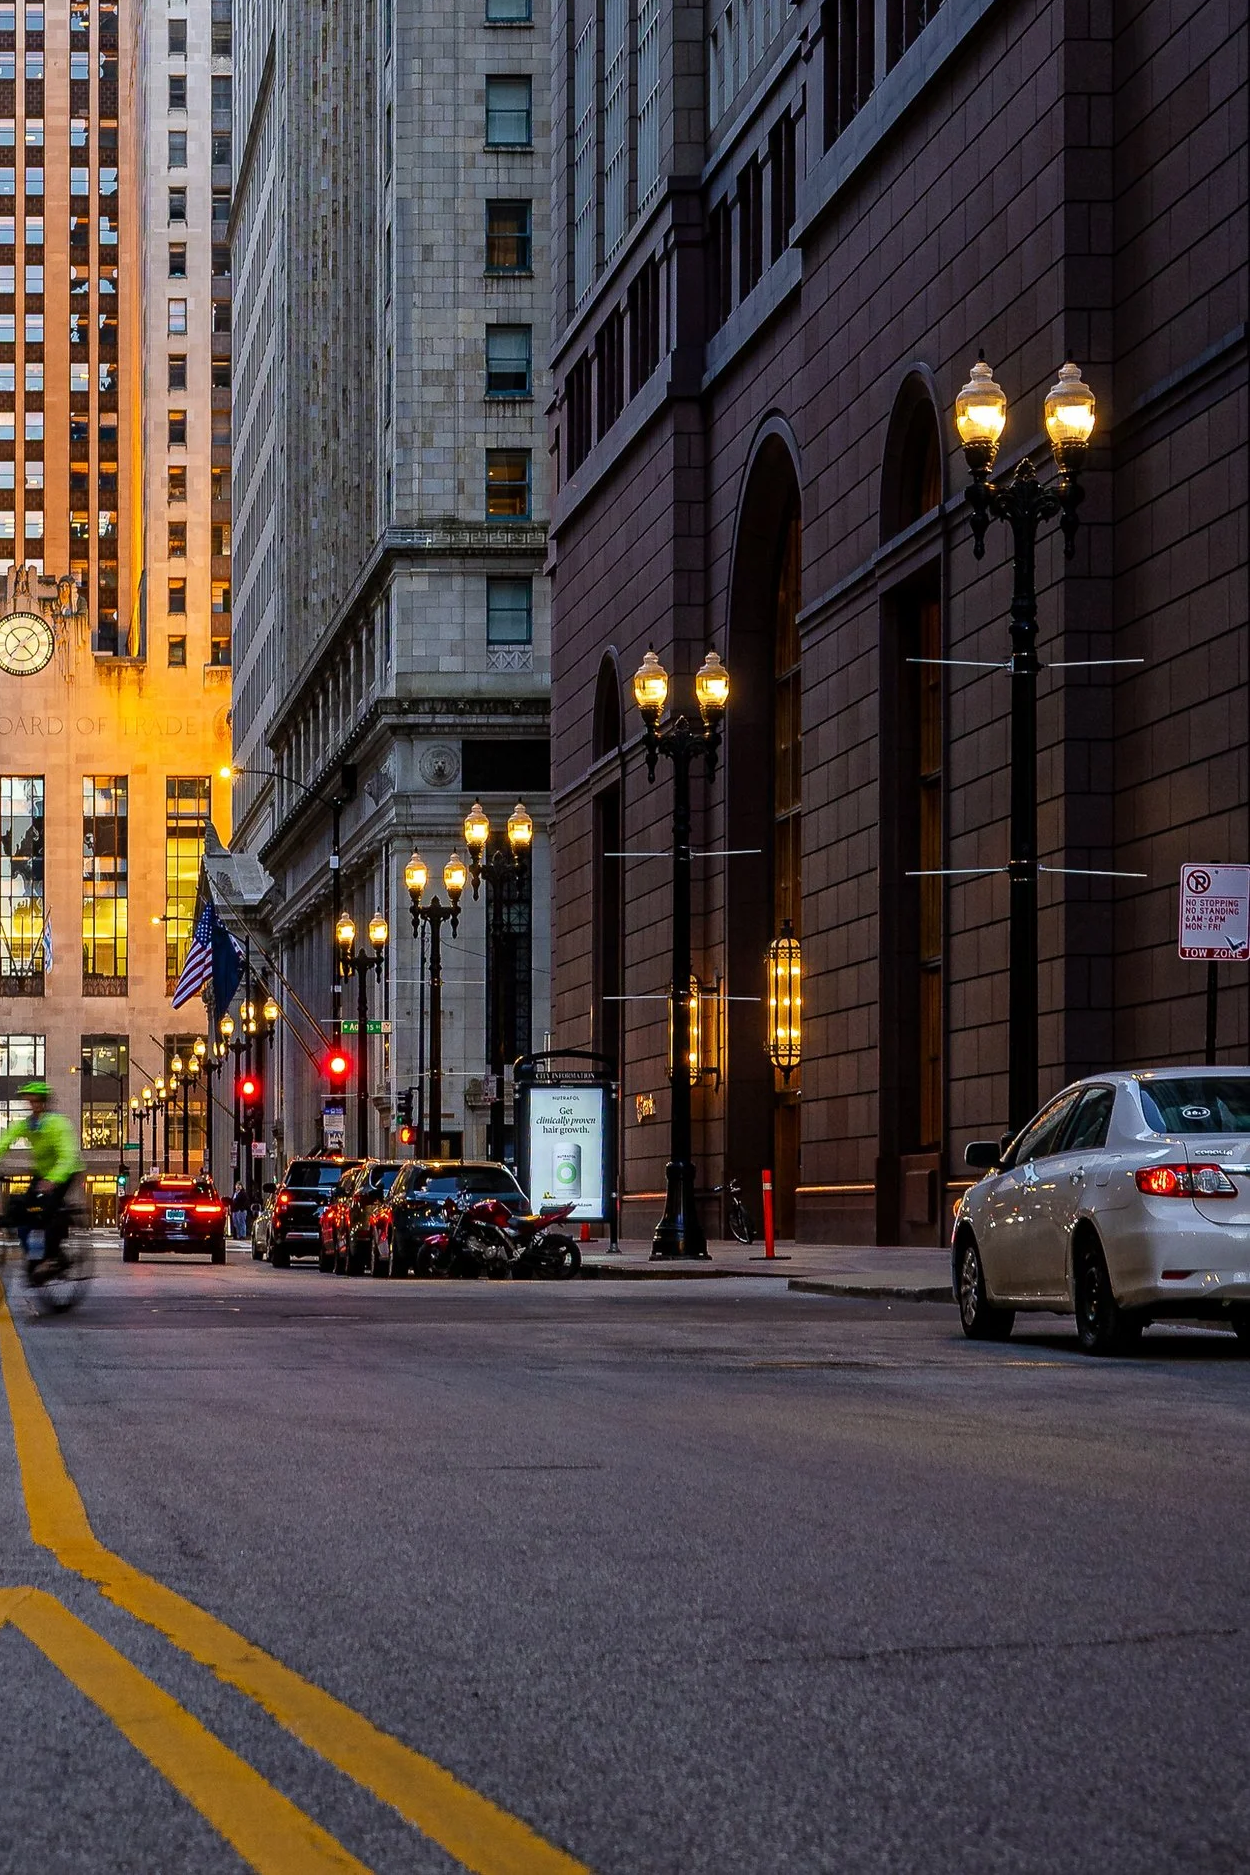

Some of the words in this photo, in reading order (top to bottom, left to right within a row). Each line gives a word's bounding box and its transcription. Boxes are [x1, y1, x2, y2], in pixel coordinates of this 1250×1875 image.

[76, 716, 108, 735] OF
[120, 716, 197, 736] TRADE
[1186, 899, 1196, 907] NO
[1186, 907, 1196, 915] NO
[1200, 908, 1240, 916] STANDING
[1186, 915, 1225, 923] 6AM-6PM
[1186, 923, 1221, 931] MON-FRI
[1185, 948, 1207, 957] TOW
[1214, 949, 1242, 958] ZONE
[559, 1107, 573, 1115] Get
[536, 1116, 570, 1126] clinically
[570, 1118, 596, 1126] proven
[542, 1126, 558, 1134] hair
[559, 1126, 590, 1135] growth.
